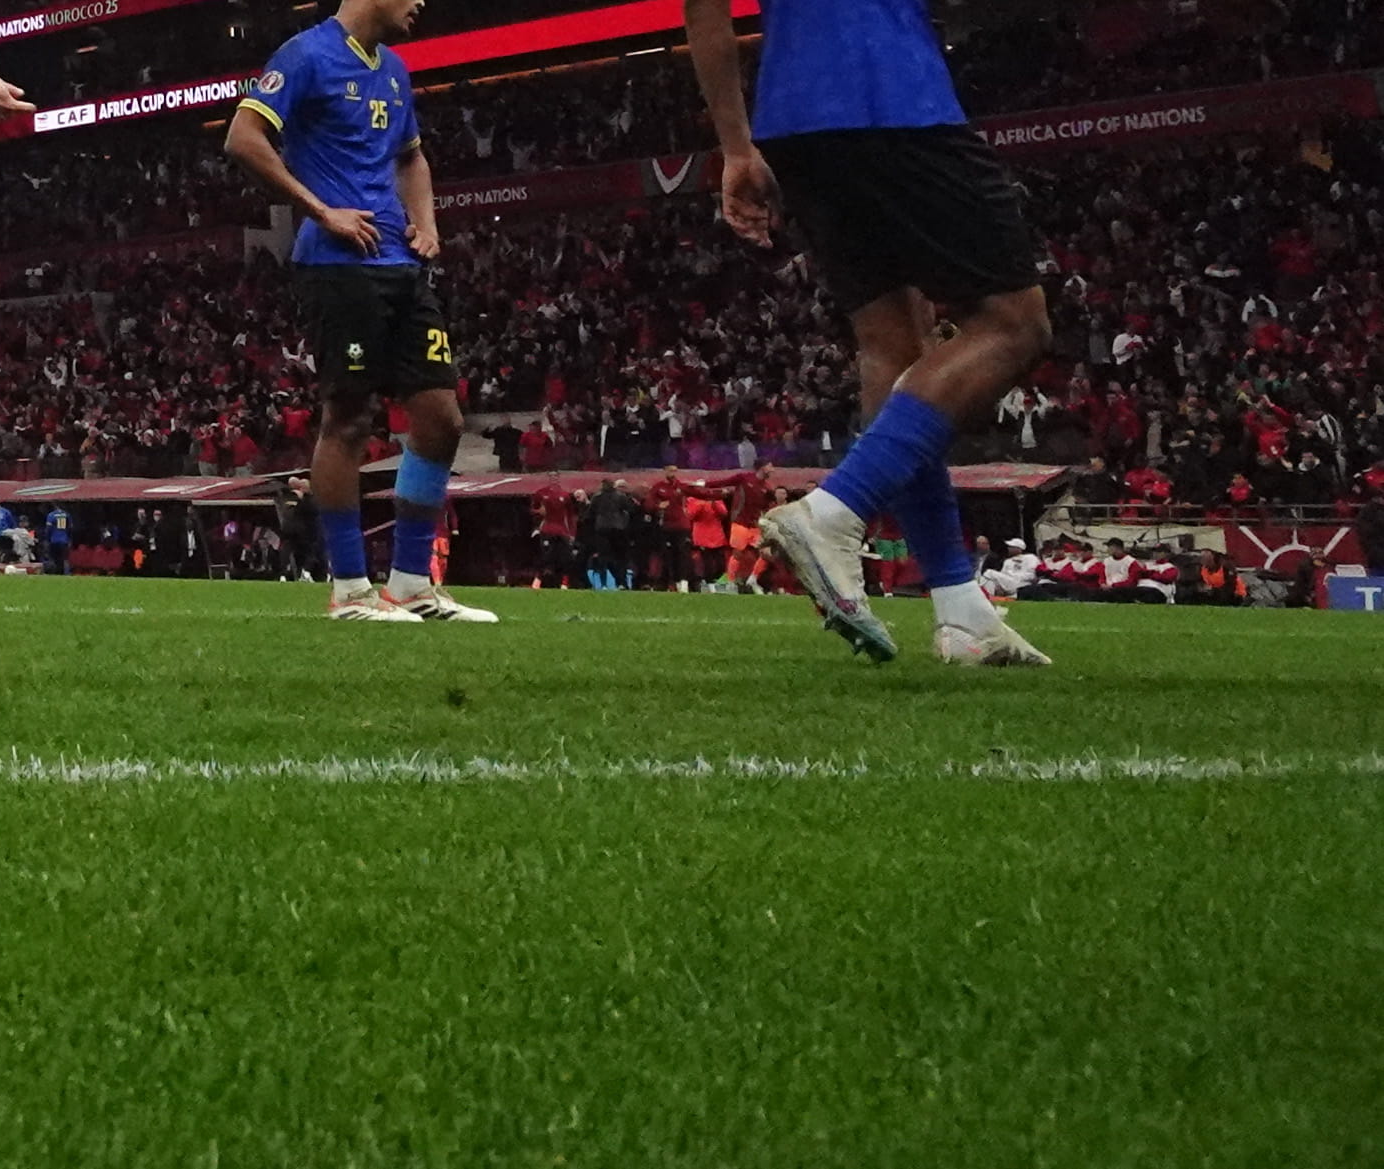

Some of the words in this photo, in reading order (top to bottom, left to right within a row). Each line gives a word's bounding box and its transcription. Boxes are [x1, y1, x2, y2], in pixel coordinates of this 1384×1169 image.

[45, 2, 104, 26] MOROCCO
[104, 0, 119, 15] 25
[57, 108, 89, 125] CAF
[99, 97, 140, 120] AFRICA
[141, 94, 165, 113] CUP
[166, 90, 183, 108] OF
[184, 80, 237, 105] NATIONS
[369, 99, 389, 129] 25
[994, 124, 1057, 147] AFRICA
[1059, 117, 1093, 139] CUP
[1095, 114, 1122, 136] OF
[1123, 105, 1208, 131] NATIONS
[474, 186, 528, 206] NATIONS
